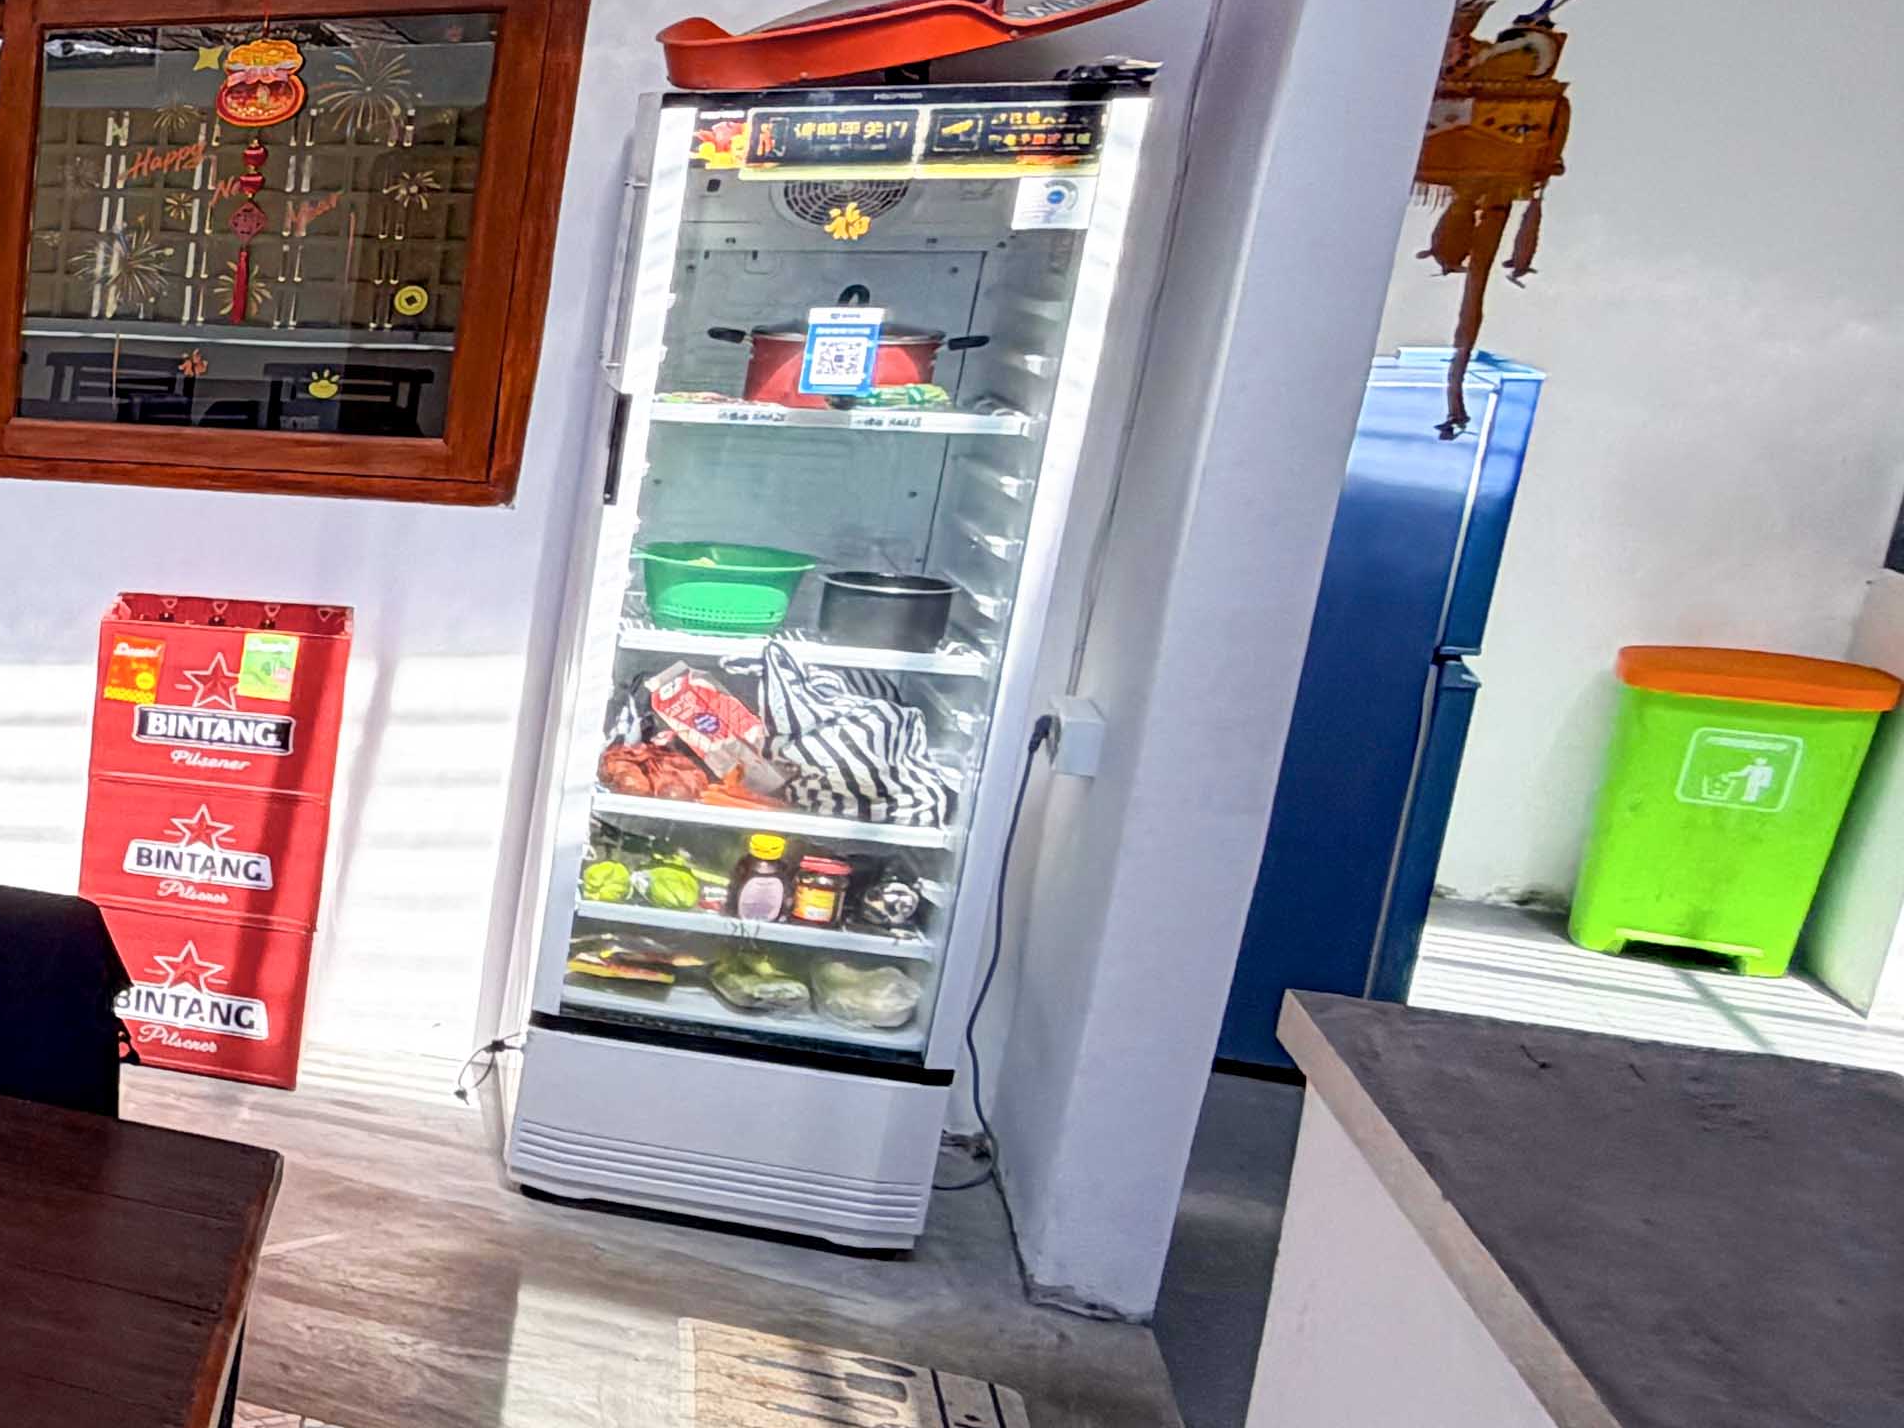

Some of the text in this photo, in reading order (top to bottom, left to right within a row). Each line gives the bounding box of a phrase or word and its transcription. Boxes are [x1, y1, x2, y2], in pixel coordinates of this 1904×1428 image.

[128, 141, 207, 178] Happy
[147, 712, 279, 746] BINTANG
[170, 749, 251, 770] Pilsener
[136, 846, 263, 882] BINTANG
[157, 879, 229, 904] Pilsener
[114, 988, 255, 1029] BINTANG
[137, 1024, 218, 1053] Pilsener
